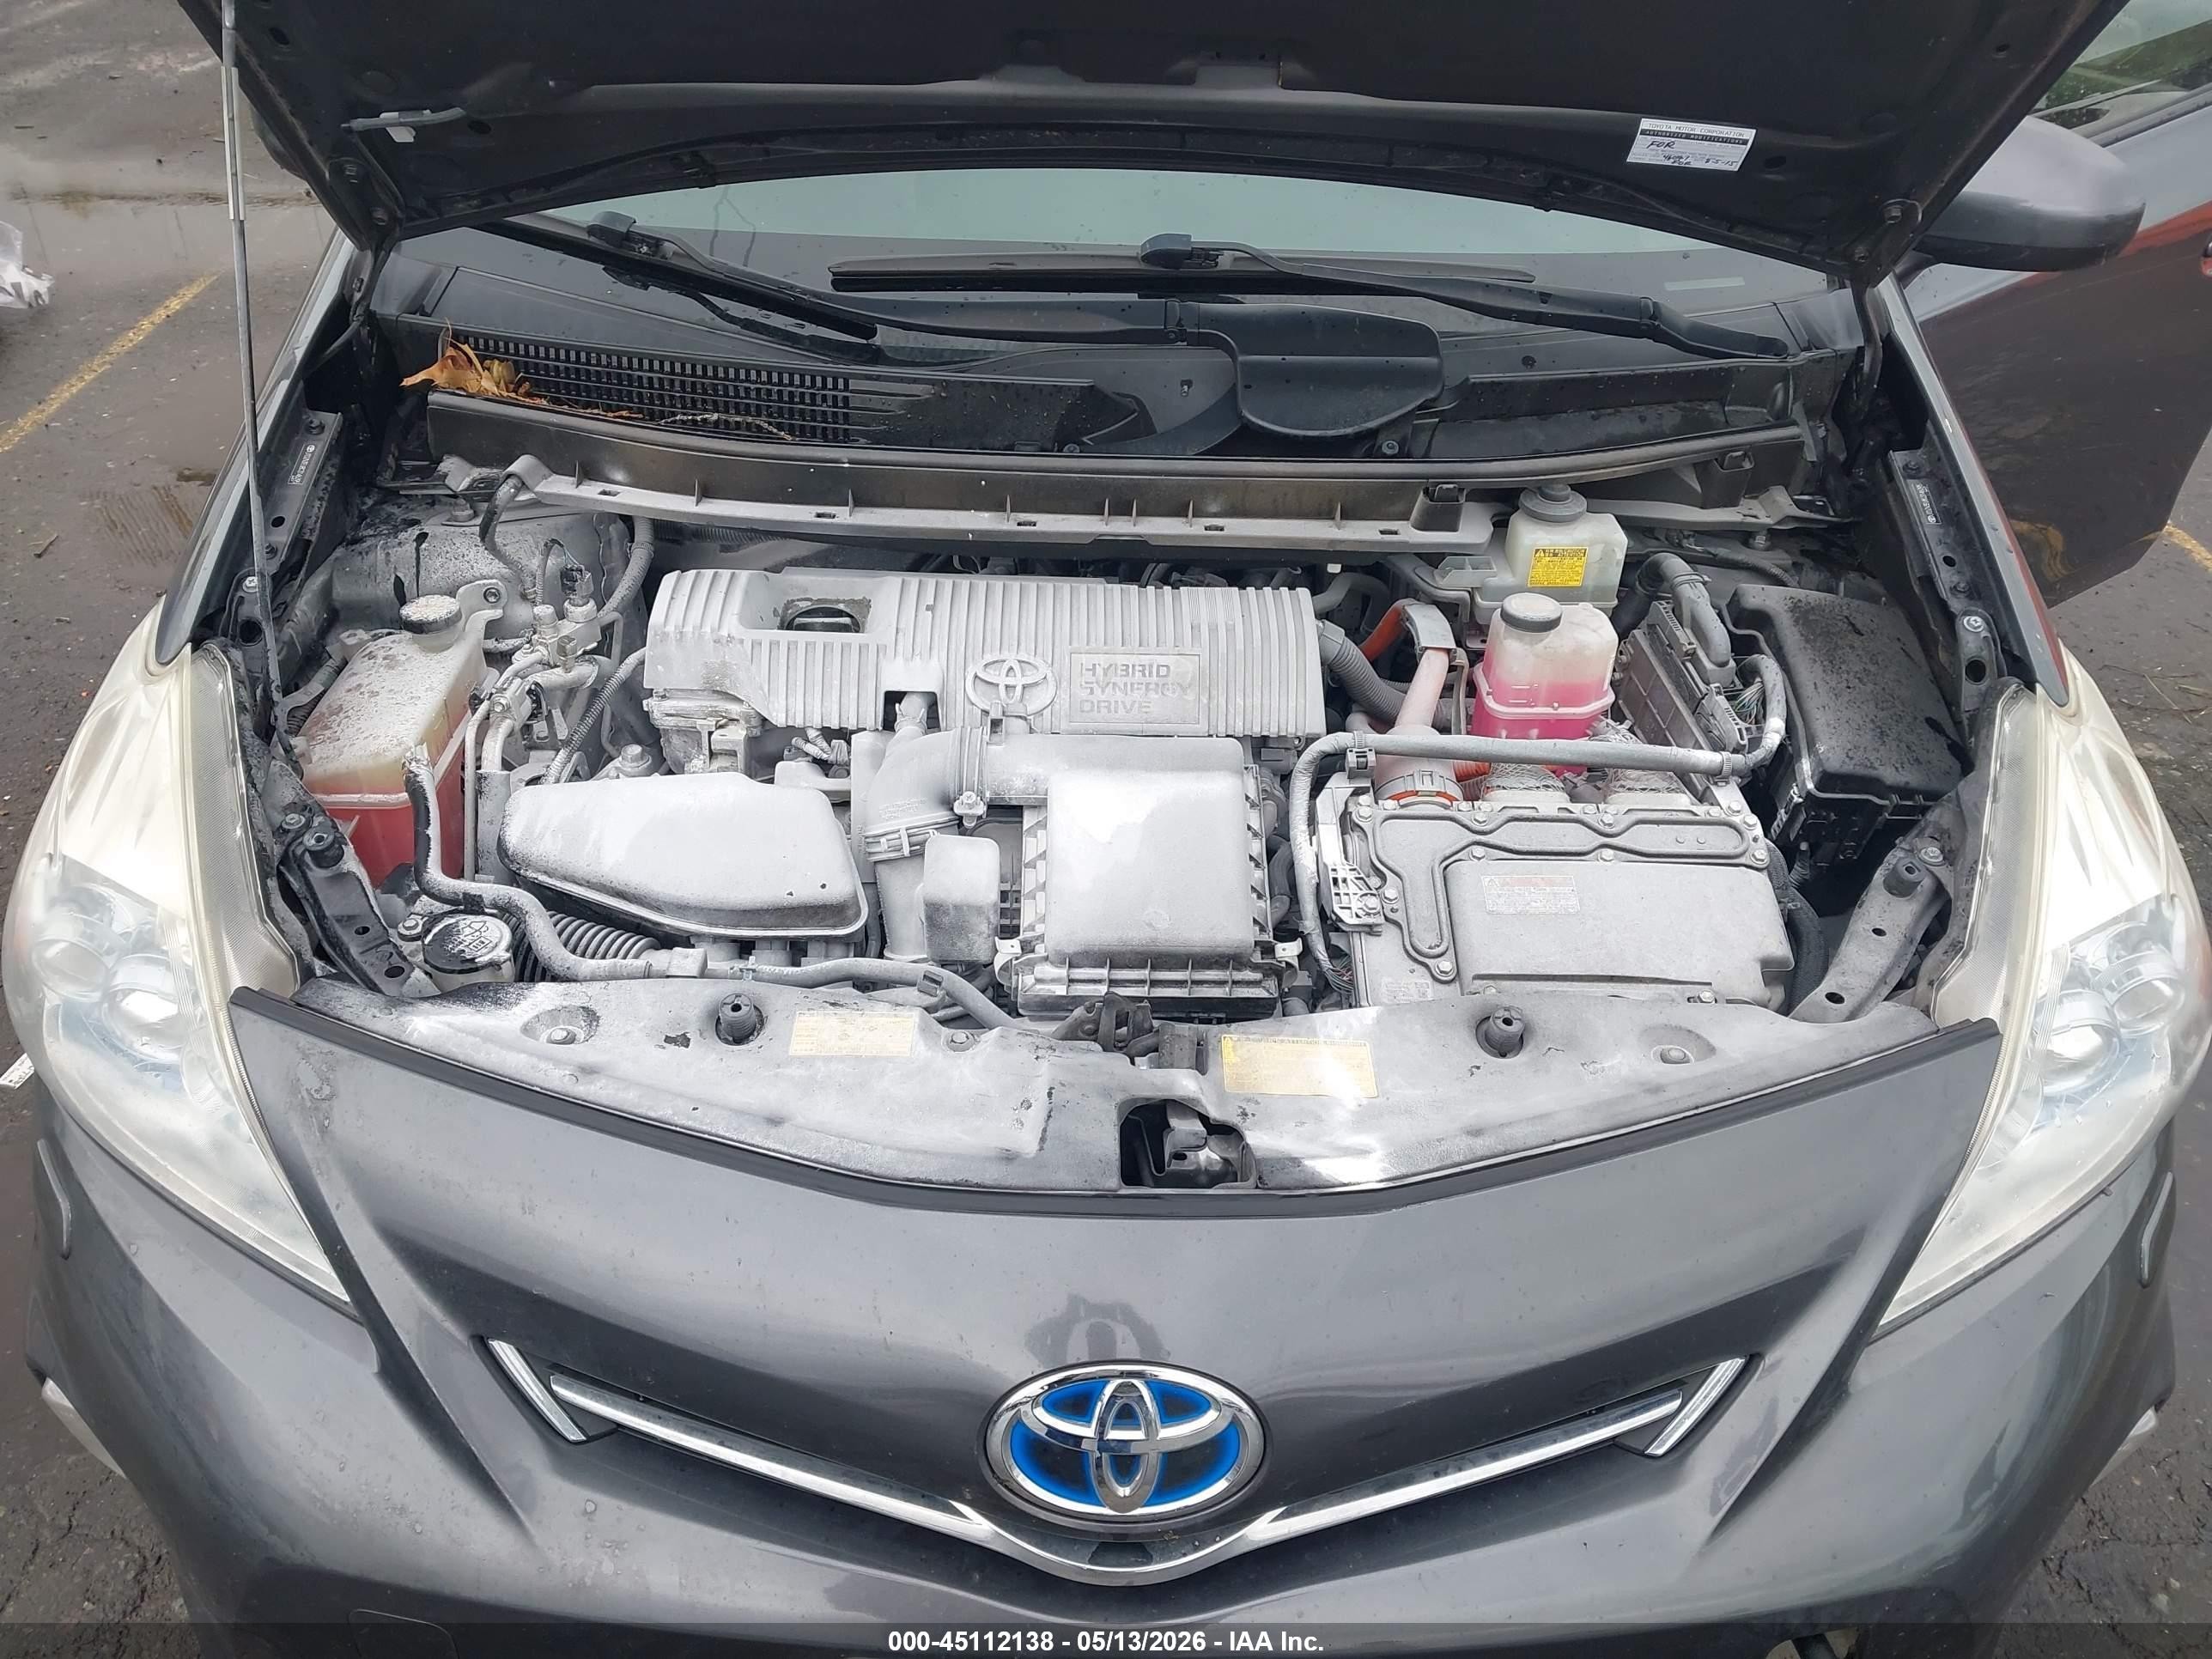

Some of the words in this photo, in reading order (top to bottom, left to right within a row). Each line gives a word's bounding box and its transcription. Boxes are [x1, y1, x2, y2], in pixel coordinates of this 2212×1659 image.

[1690, 135, 1743, 143] MODIFICATIONS
[1700, 128, 1746, 137] CORPORATION
[1080, 662, 1170, 678] HYBRID
[1079, 680, 1192, 696] SYNERGY
[1079, 699, 1153, 714] DRIVE
